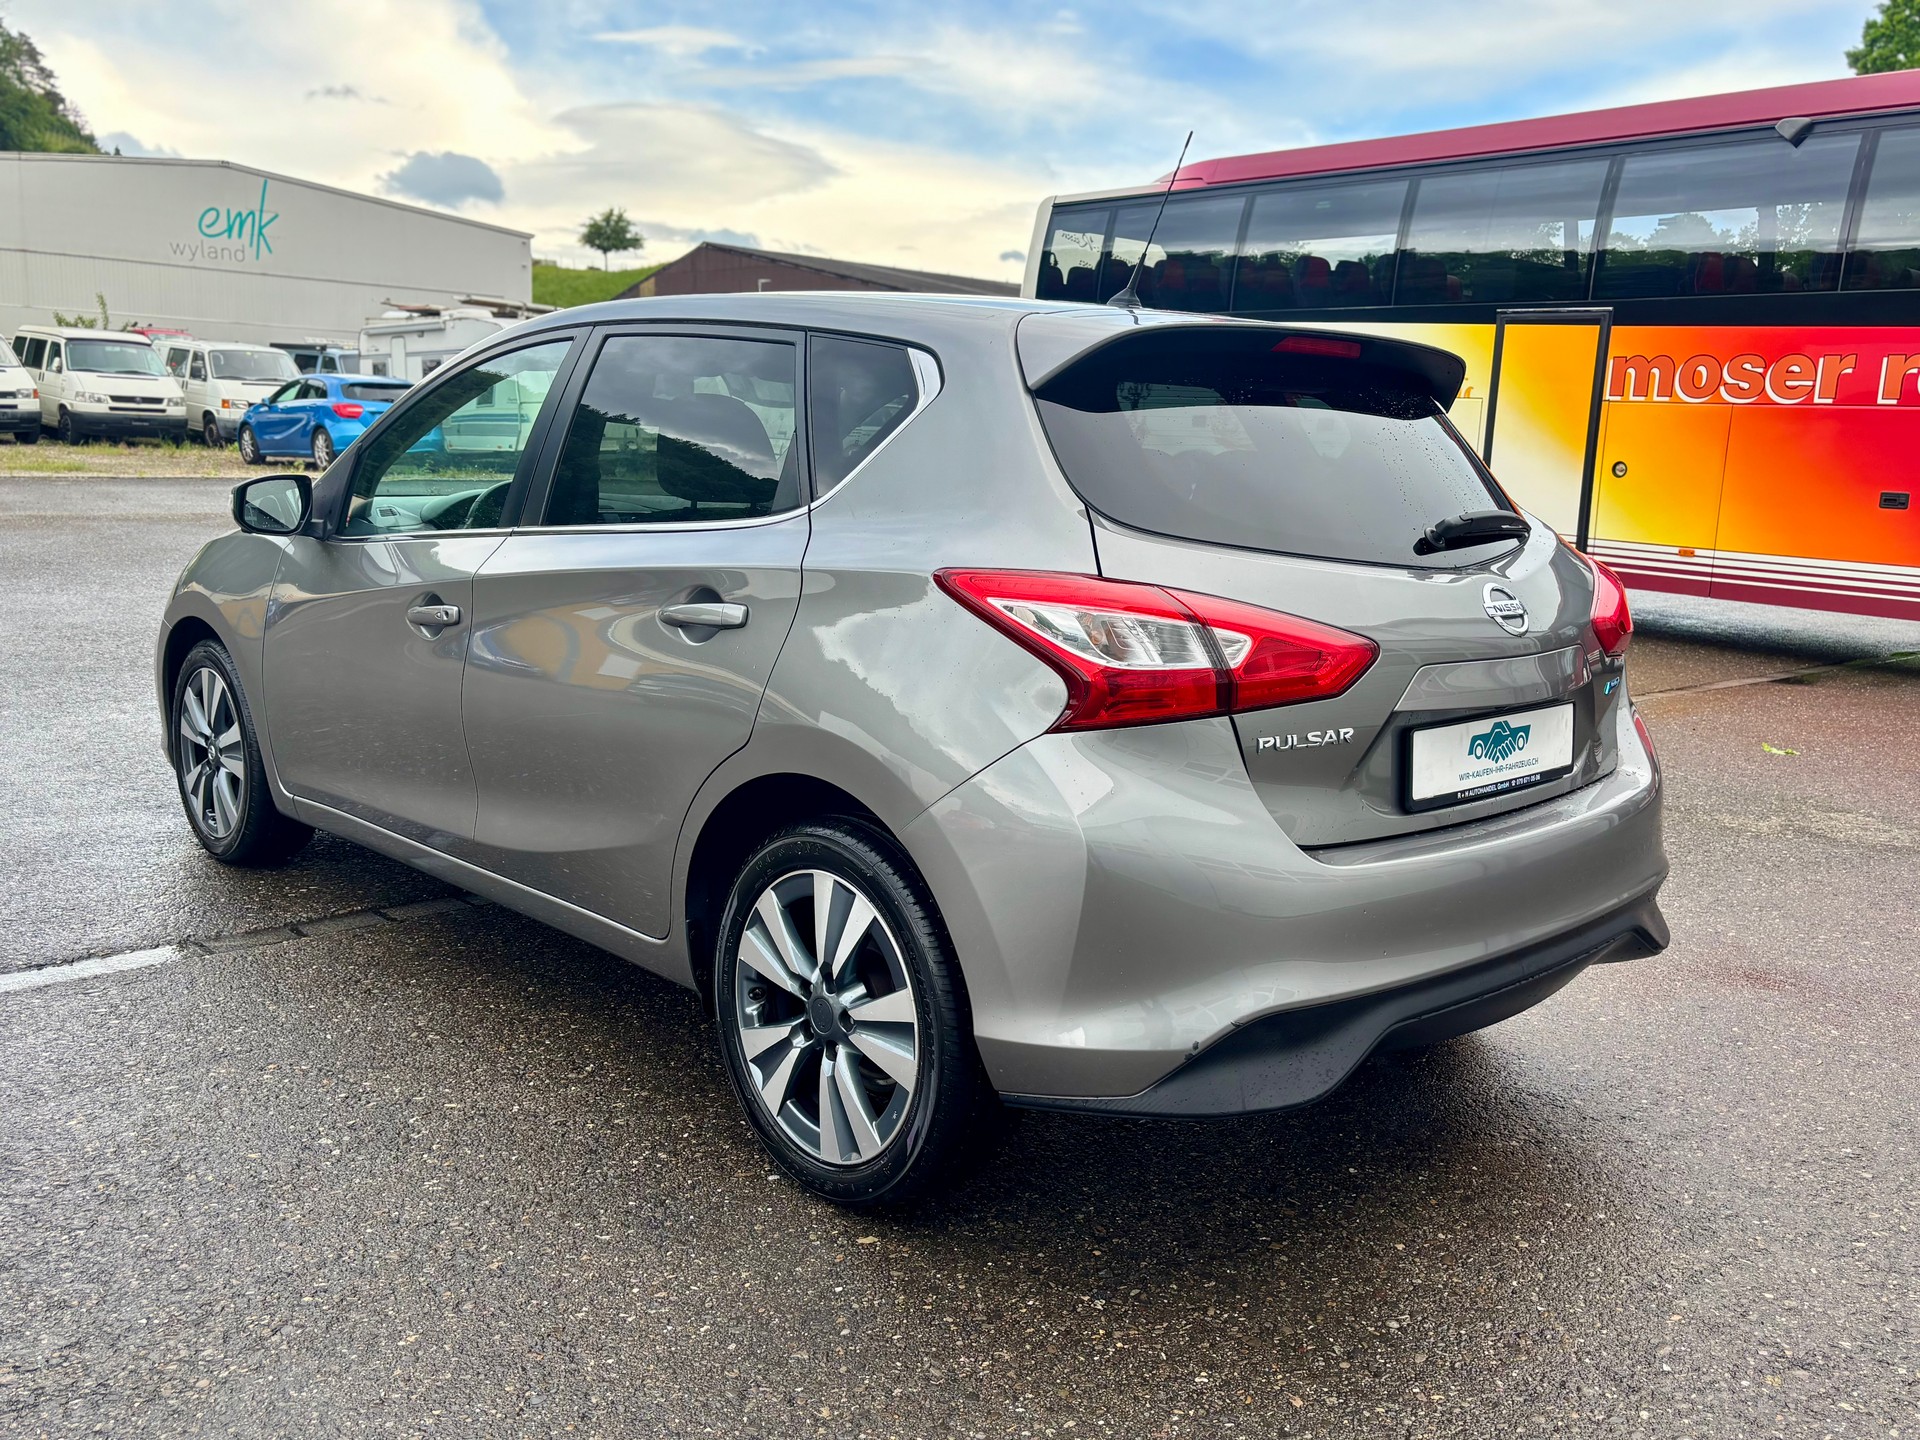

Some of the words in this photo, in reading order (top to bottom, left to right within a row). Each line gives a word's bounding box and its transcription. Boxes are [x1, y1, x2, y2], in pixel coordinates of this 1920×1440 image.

[198, 178, 279, 261] emk
[169, 239, 246, 262] wyland
[1606, 353, 1857, 405] moser
[1257, 727, 1354, 755] PULSAR
[1458, 758, 1539, 781] WIR-KAUFEN-IHR-FAHRZEUG.CH
